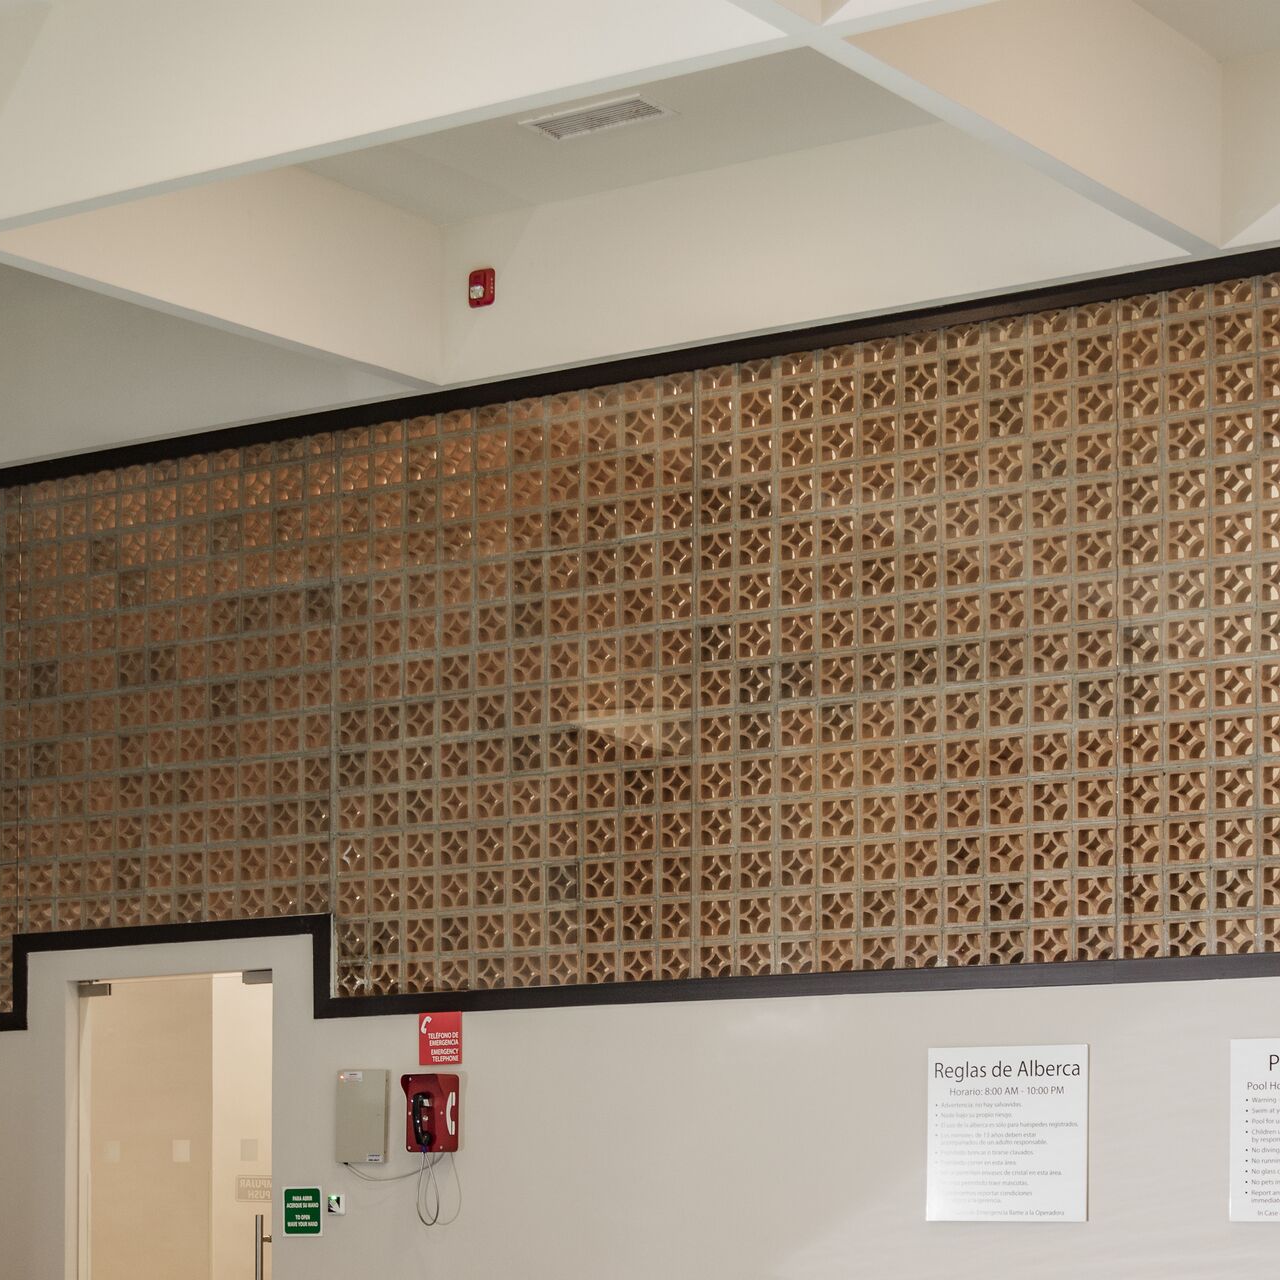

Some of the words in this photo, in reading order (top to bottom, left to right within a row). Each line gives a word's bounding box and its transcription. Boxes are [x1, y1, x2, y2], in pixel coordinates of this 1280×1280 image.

[934, 1061, 987, 1082] Reglas
[992, 1060, 1013, 1077] de
[1017, 1059, 1081, 1077] Alberca
[949, 1088, 983, 1096] Horario:
[984, 1087, 1002, 1096] 8:00
[1004, 1087, 1019, 1095] AM
[1027, 1086, 1049, 1095] 10:00
[1051, 1086, 1065, 1095] PM
[1247, 1082, 1268, 1091] Pool
[1258, 1209, 1264, 1217] In
[1264, 1209, 1278, 1217] Case
